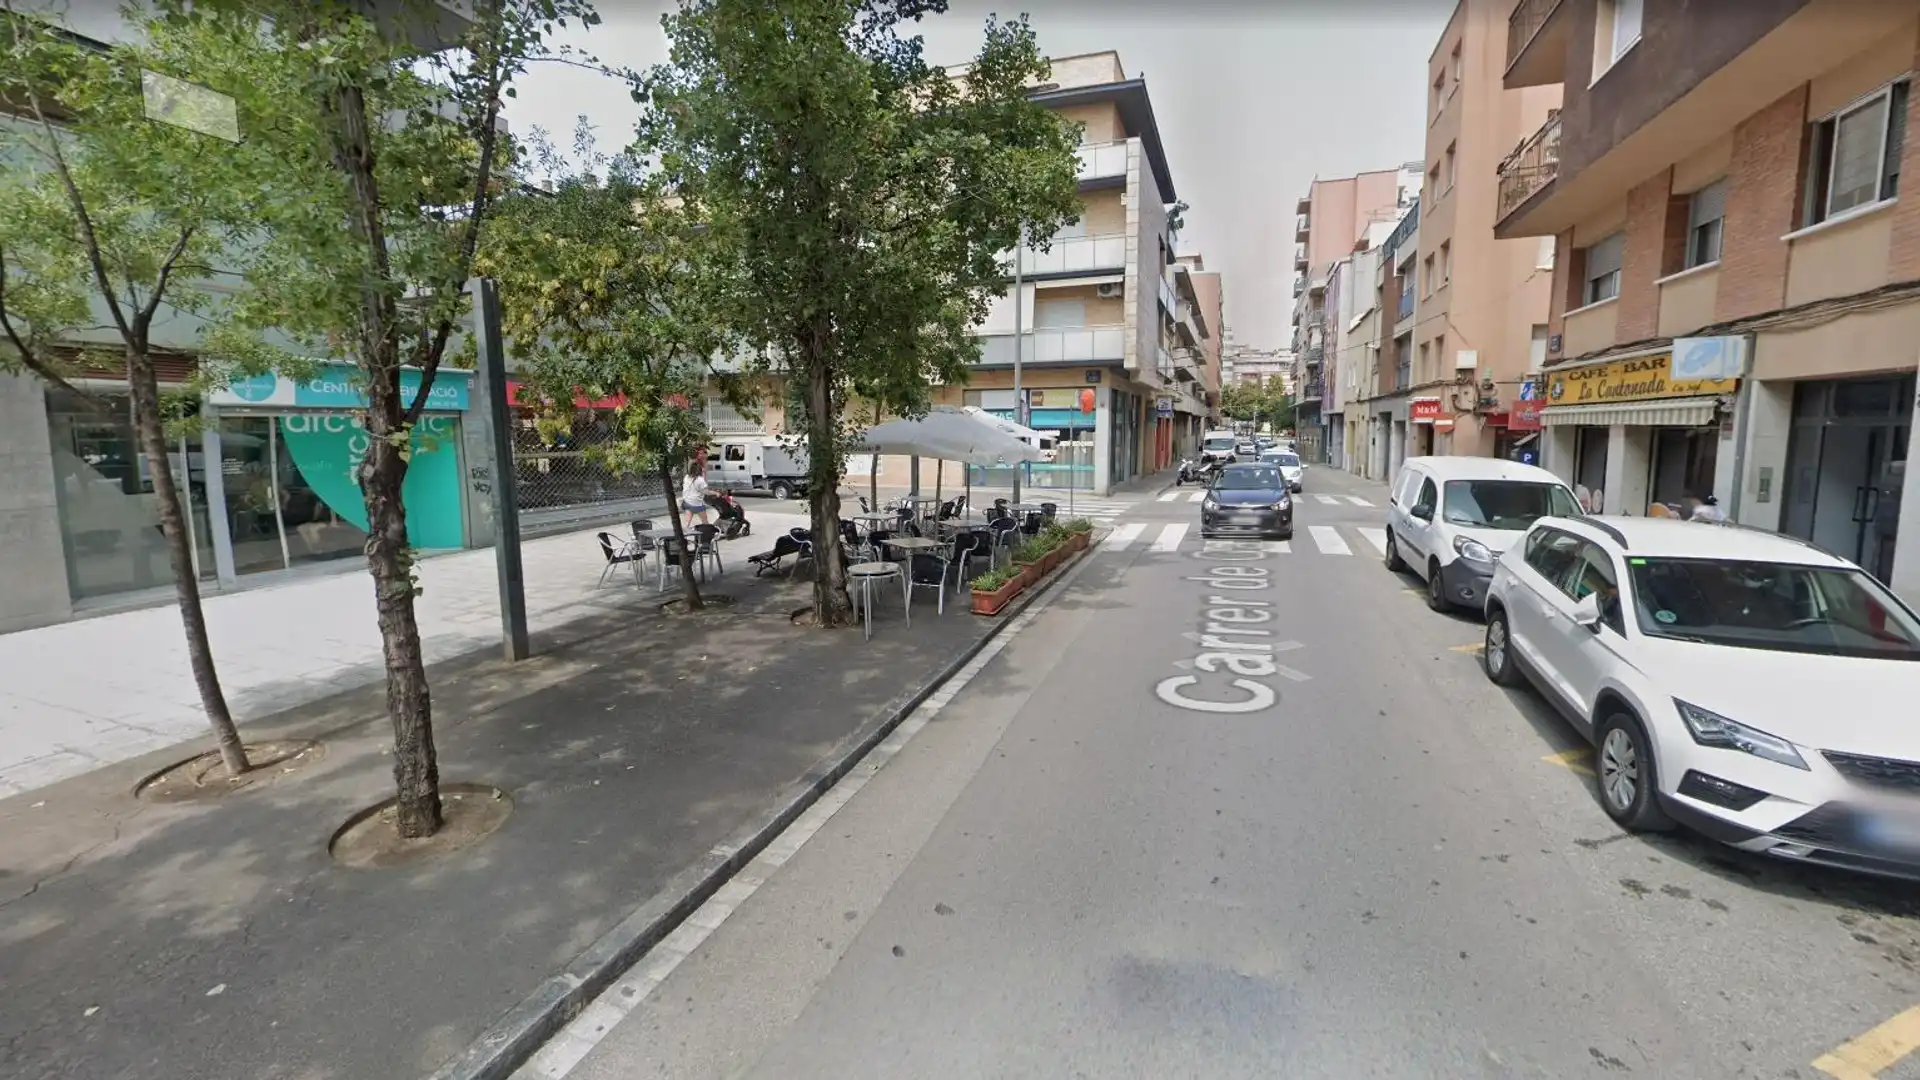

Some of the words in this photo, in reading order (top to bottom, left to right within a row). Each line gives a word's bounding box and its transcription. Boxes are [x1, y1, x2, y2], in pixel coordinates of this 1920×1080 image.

[1623, 358, 1667, 374] BAR
[1577, 381, 1593, 401] La
[1597, 373, 1666, 400] Cantonada
[285, 415, 346, 433] arc
[1523, 452, 1532, 462] P
